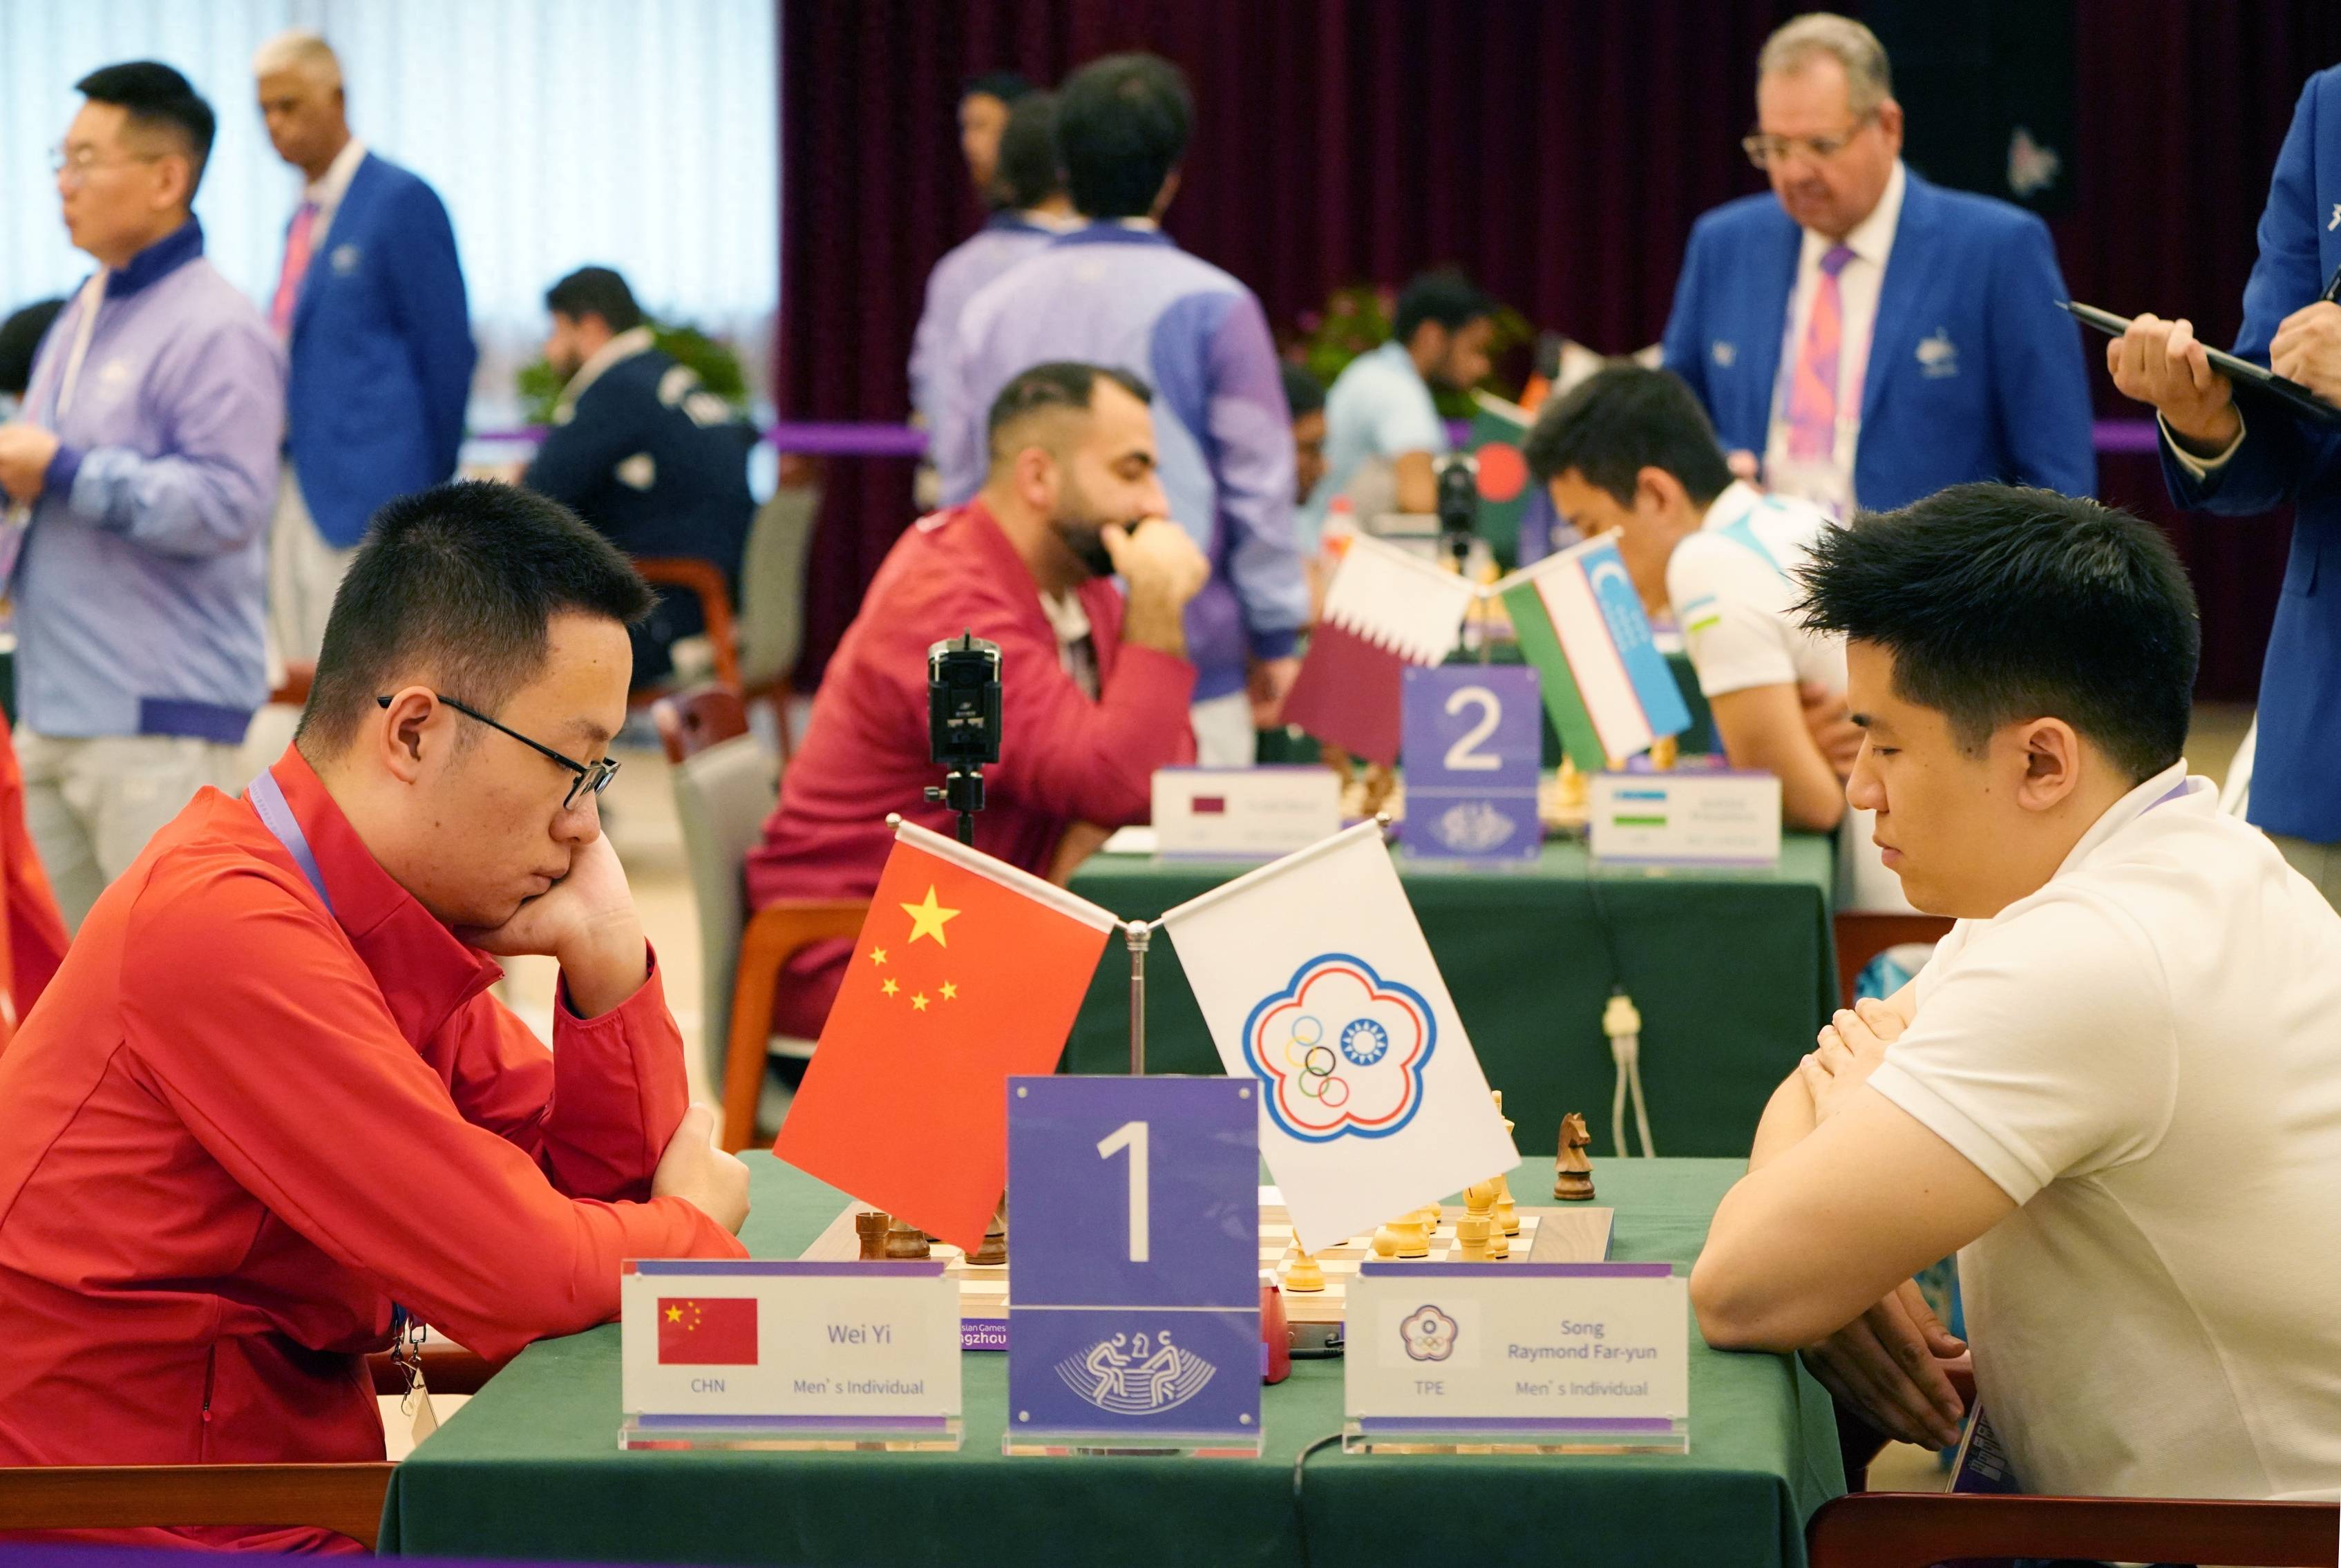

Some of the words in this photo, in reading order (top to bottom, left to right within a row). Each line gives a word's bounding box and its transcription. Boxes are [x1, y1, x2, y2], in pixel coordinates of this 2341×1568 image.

[1444, 686, 1501, 771] 2
[1097, 1120, 1148, 1263] 1
[827, 1324, 866, 1344] Wei
[872, 1324, 890, 1344] Yi
[1561, 1320, 1604, 1339] Song
[1508, 1344, 1589, 1363] Raymond
[1593, 1344, 1658, 1363] Far-yun
[691, 1379, 725, 1393] CHN
[847, 1379, 924, 1395] Individual
[1414, 1381, 1444, 1395] TPE
[1570, 1381, 1649, 1396] Individual
